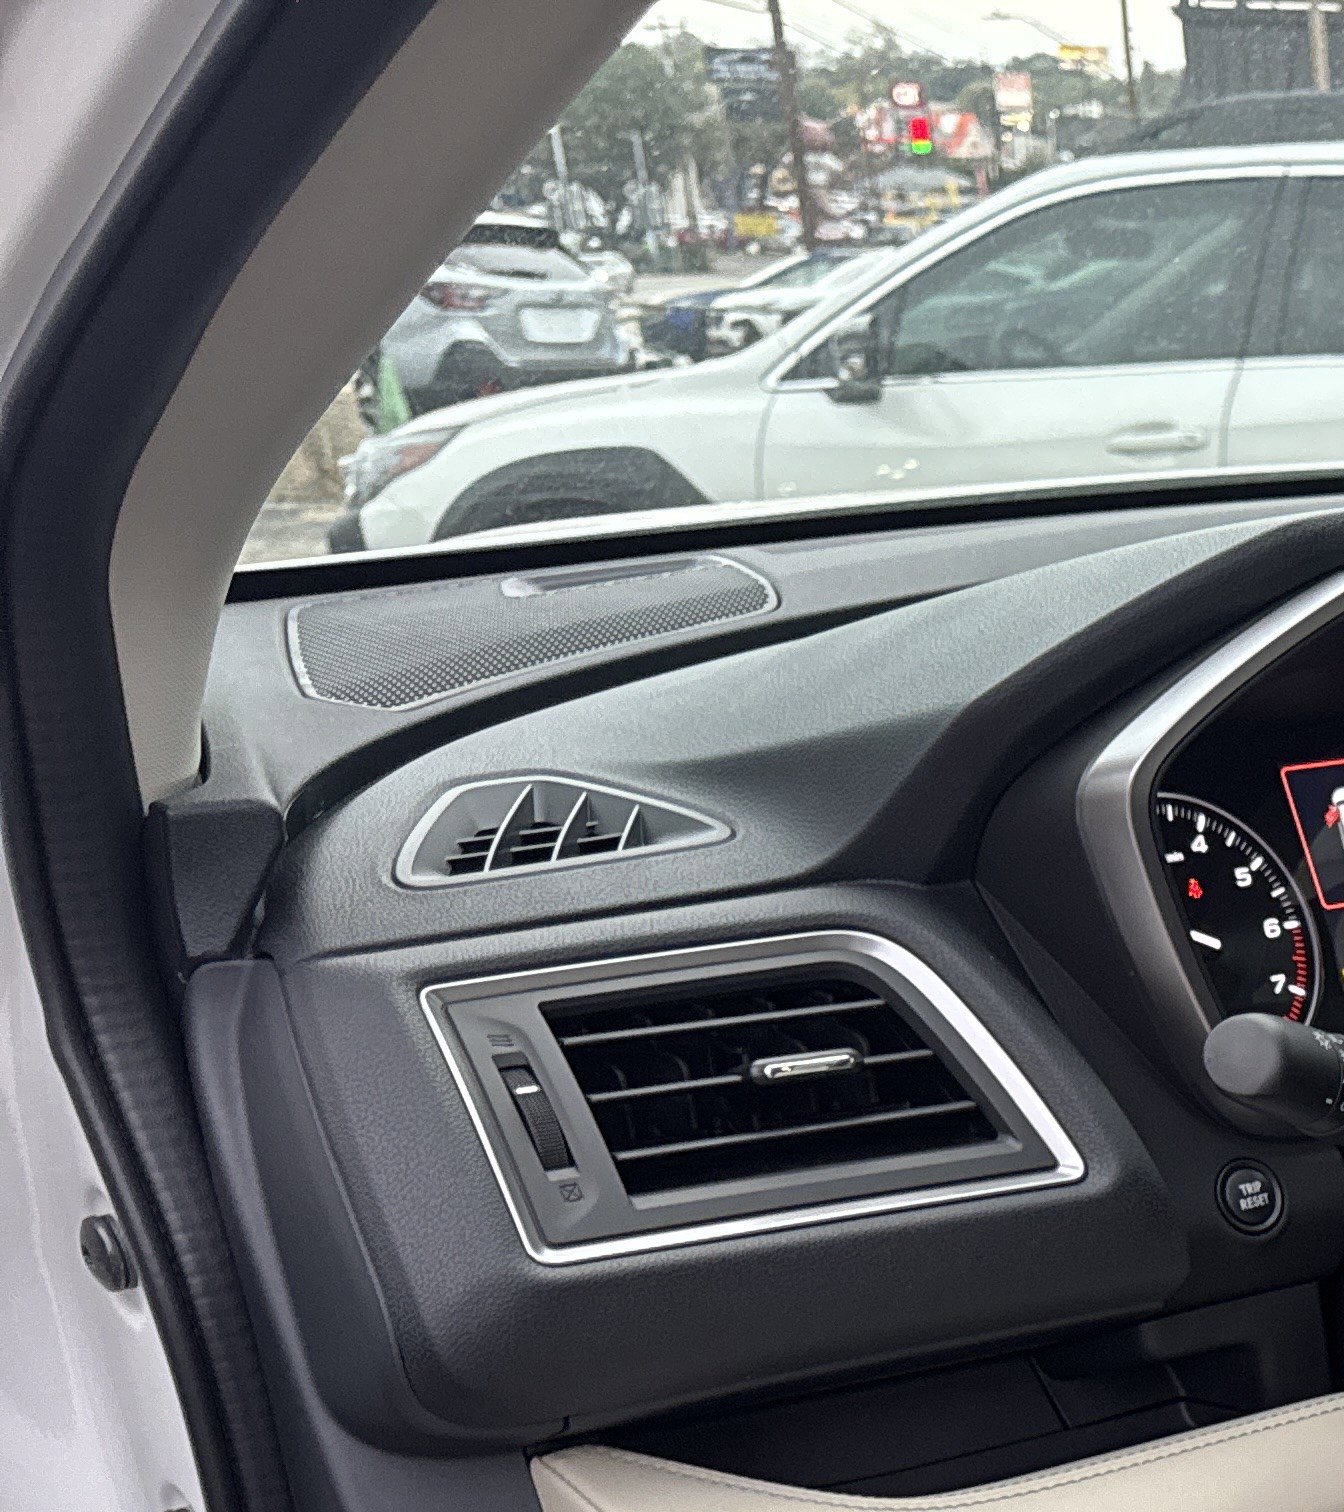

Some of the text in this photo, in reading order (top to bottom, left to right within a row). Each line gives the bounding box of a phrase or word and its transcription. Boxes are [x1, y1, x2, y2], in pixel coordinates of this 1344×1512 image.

[1190, 834, 1208, 853] 4
[1234, 866, 1252, 887] 5
[1262, 917, 1281, 938] 6
[1269, 973, 1286, 994] 7
[1239, 1192, 1269, 1211] RESET
